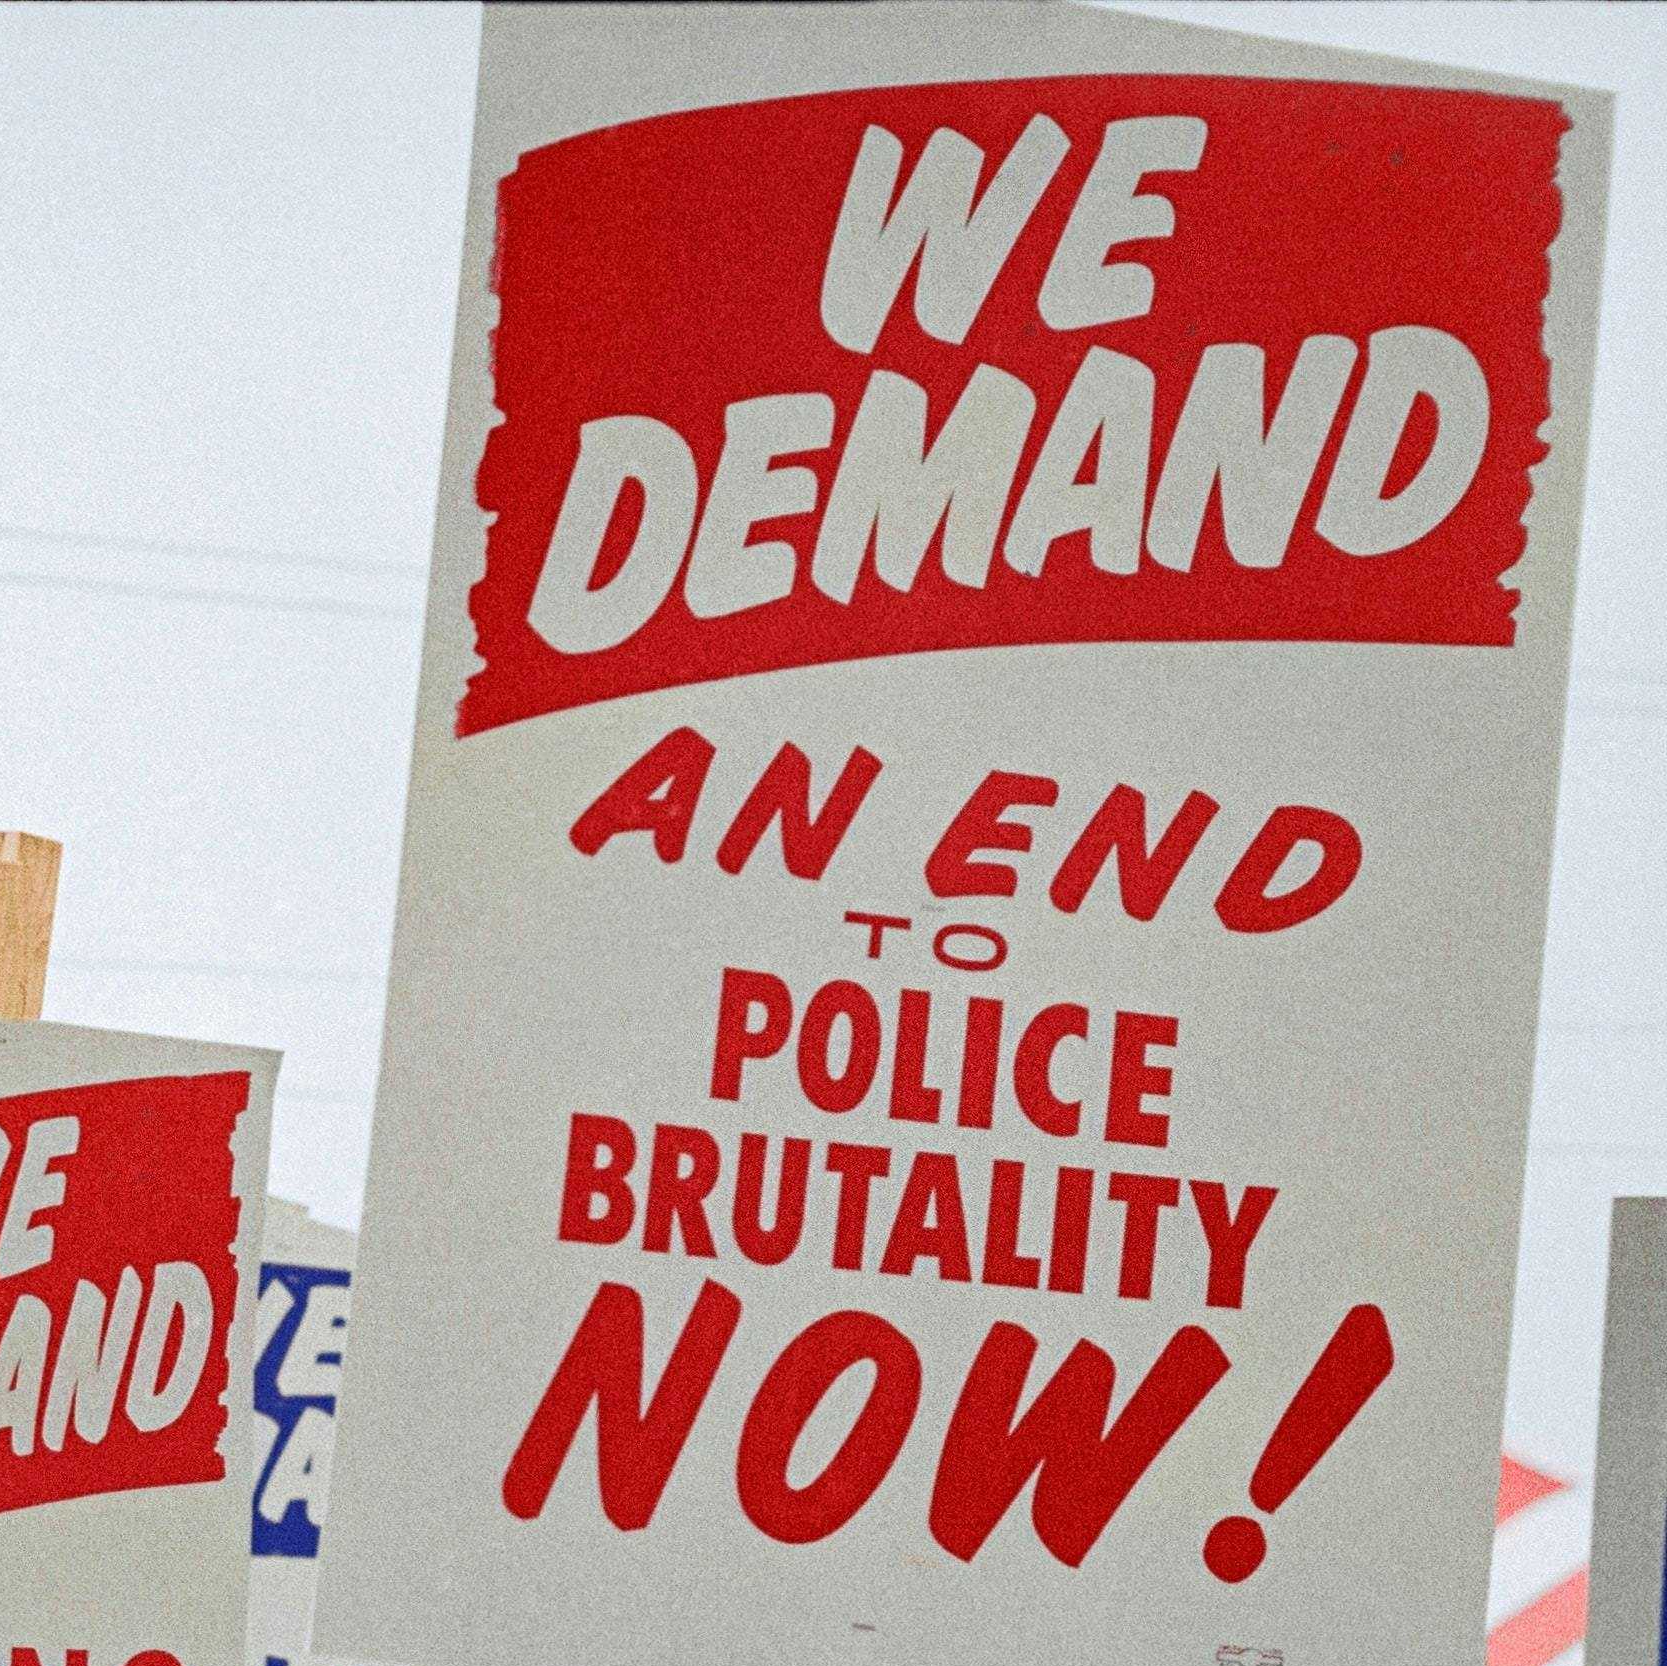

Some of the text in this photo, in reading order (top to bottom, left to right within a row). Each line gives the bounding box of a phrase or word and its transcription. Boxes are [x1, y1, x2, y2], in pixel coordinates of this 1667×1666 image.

[819, 113, 1210, 356] WE
[526, 324, 1491, 656] DEMAND
[568, 726, 1363, 935] AN END
[844, 910, 1008, 972] TO
[709, 966, 1179, 1149] POLICE
[557, 1112, 1278, 1310] BRUTALITY
[501, 1278, 1396, 1585] NOW!
